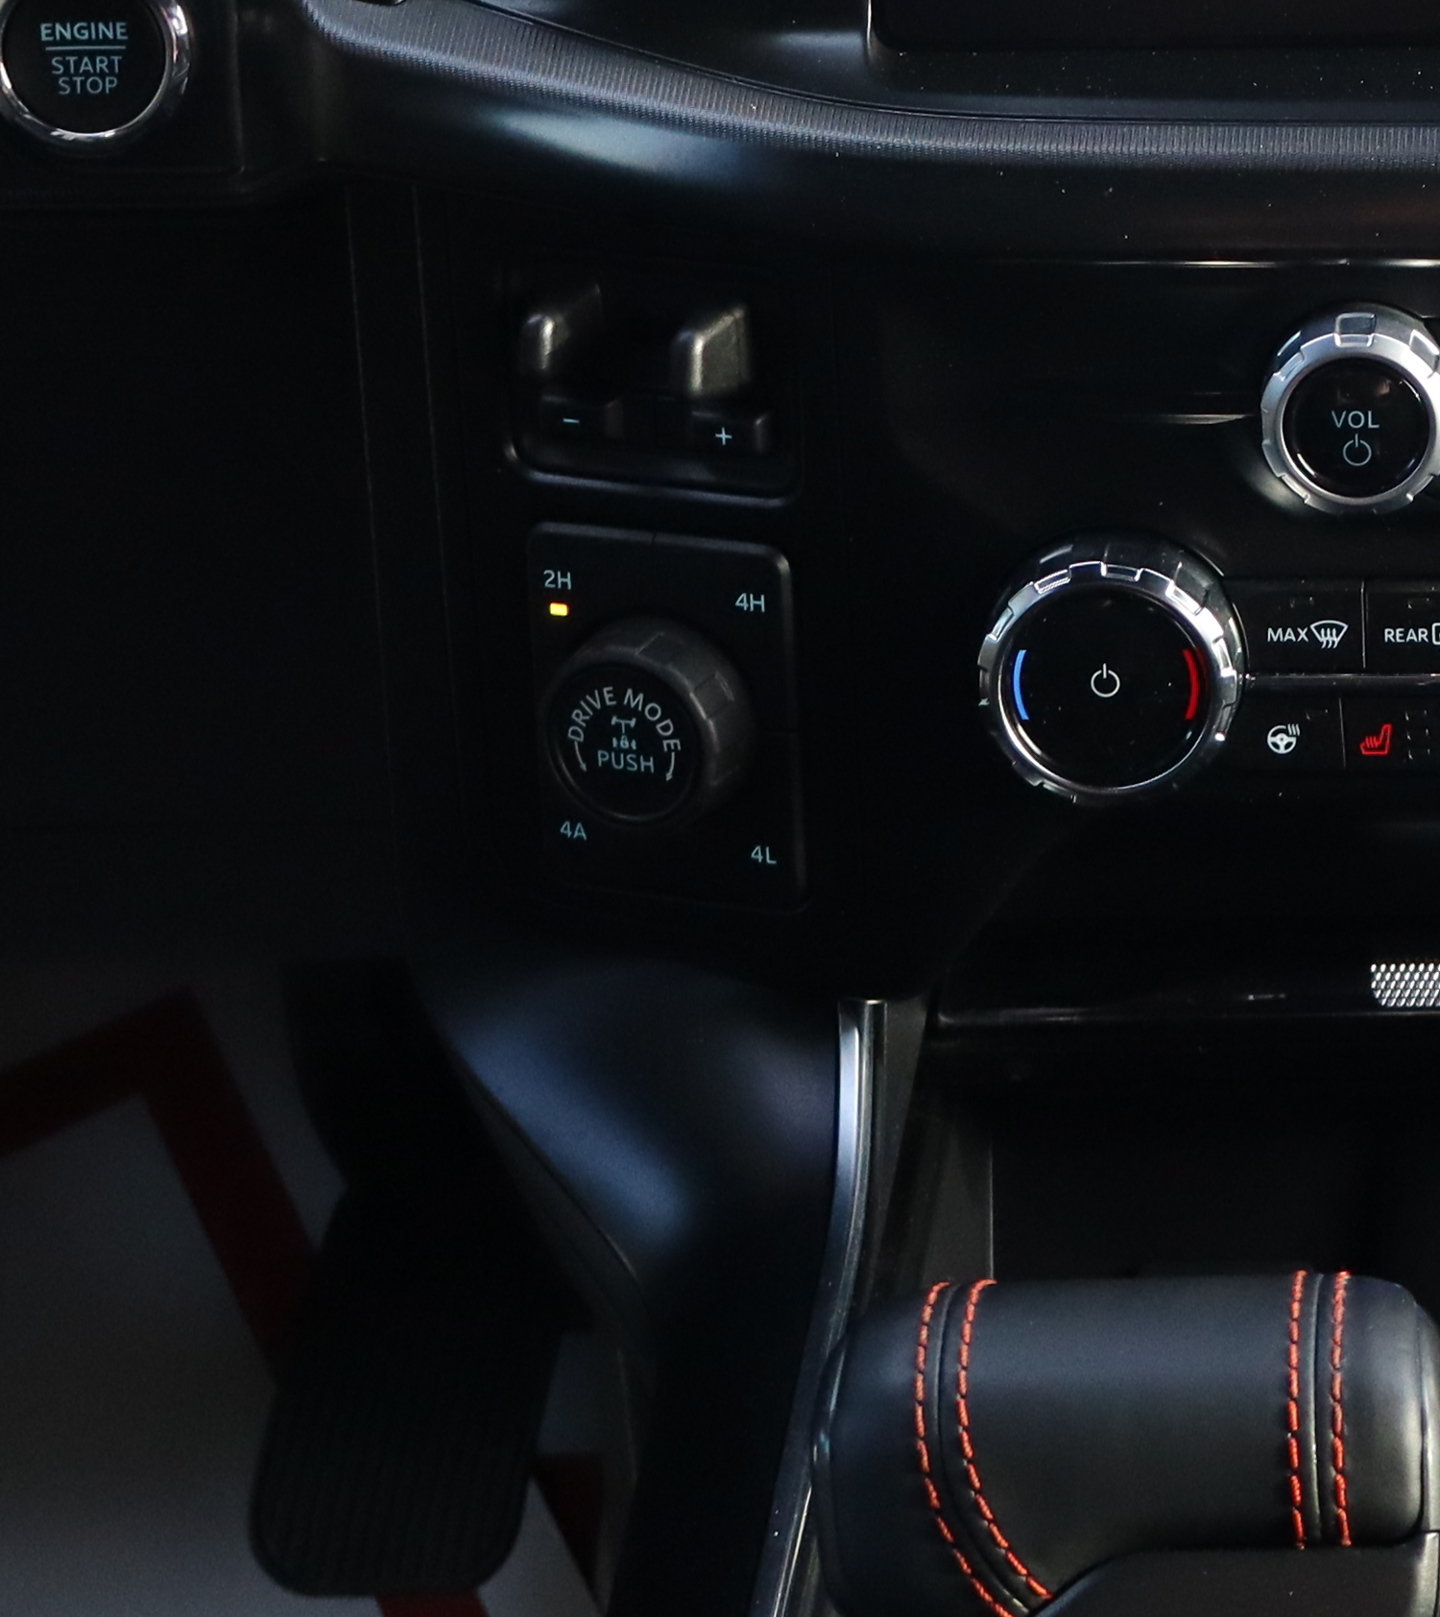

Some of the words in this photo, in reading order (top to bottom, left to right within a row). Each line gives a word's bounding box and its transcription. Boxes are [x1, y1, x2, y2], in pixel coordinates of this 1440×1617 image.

[40, 21, 129, 42] ENGINE
[51, 56, 122, 75] START
[58, 77, 118, 95] STOP
[1331, 410, 1380, 429] VOL
[543, 570, 572, 590] 2H
[735, 592, 766, 613] 4H
[1267, 627, 1309, 643] MAX
[1384, 627, 1429, 644] REAR
[567, 686, 617, 744] DRIVE
[624, 688, 681, 752] MODE
[597, 749, 655, 774] PUSH
[560, 821, 588, 840] 4A
[751, 844, 777, 865] 4L
